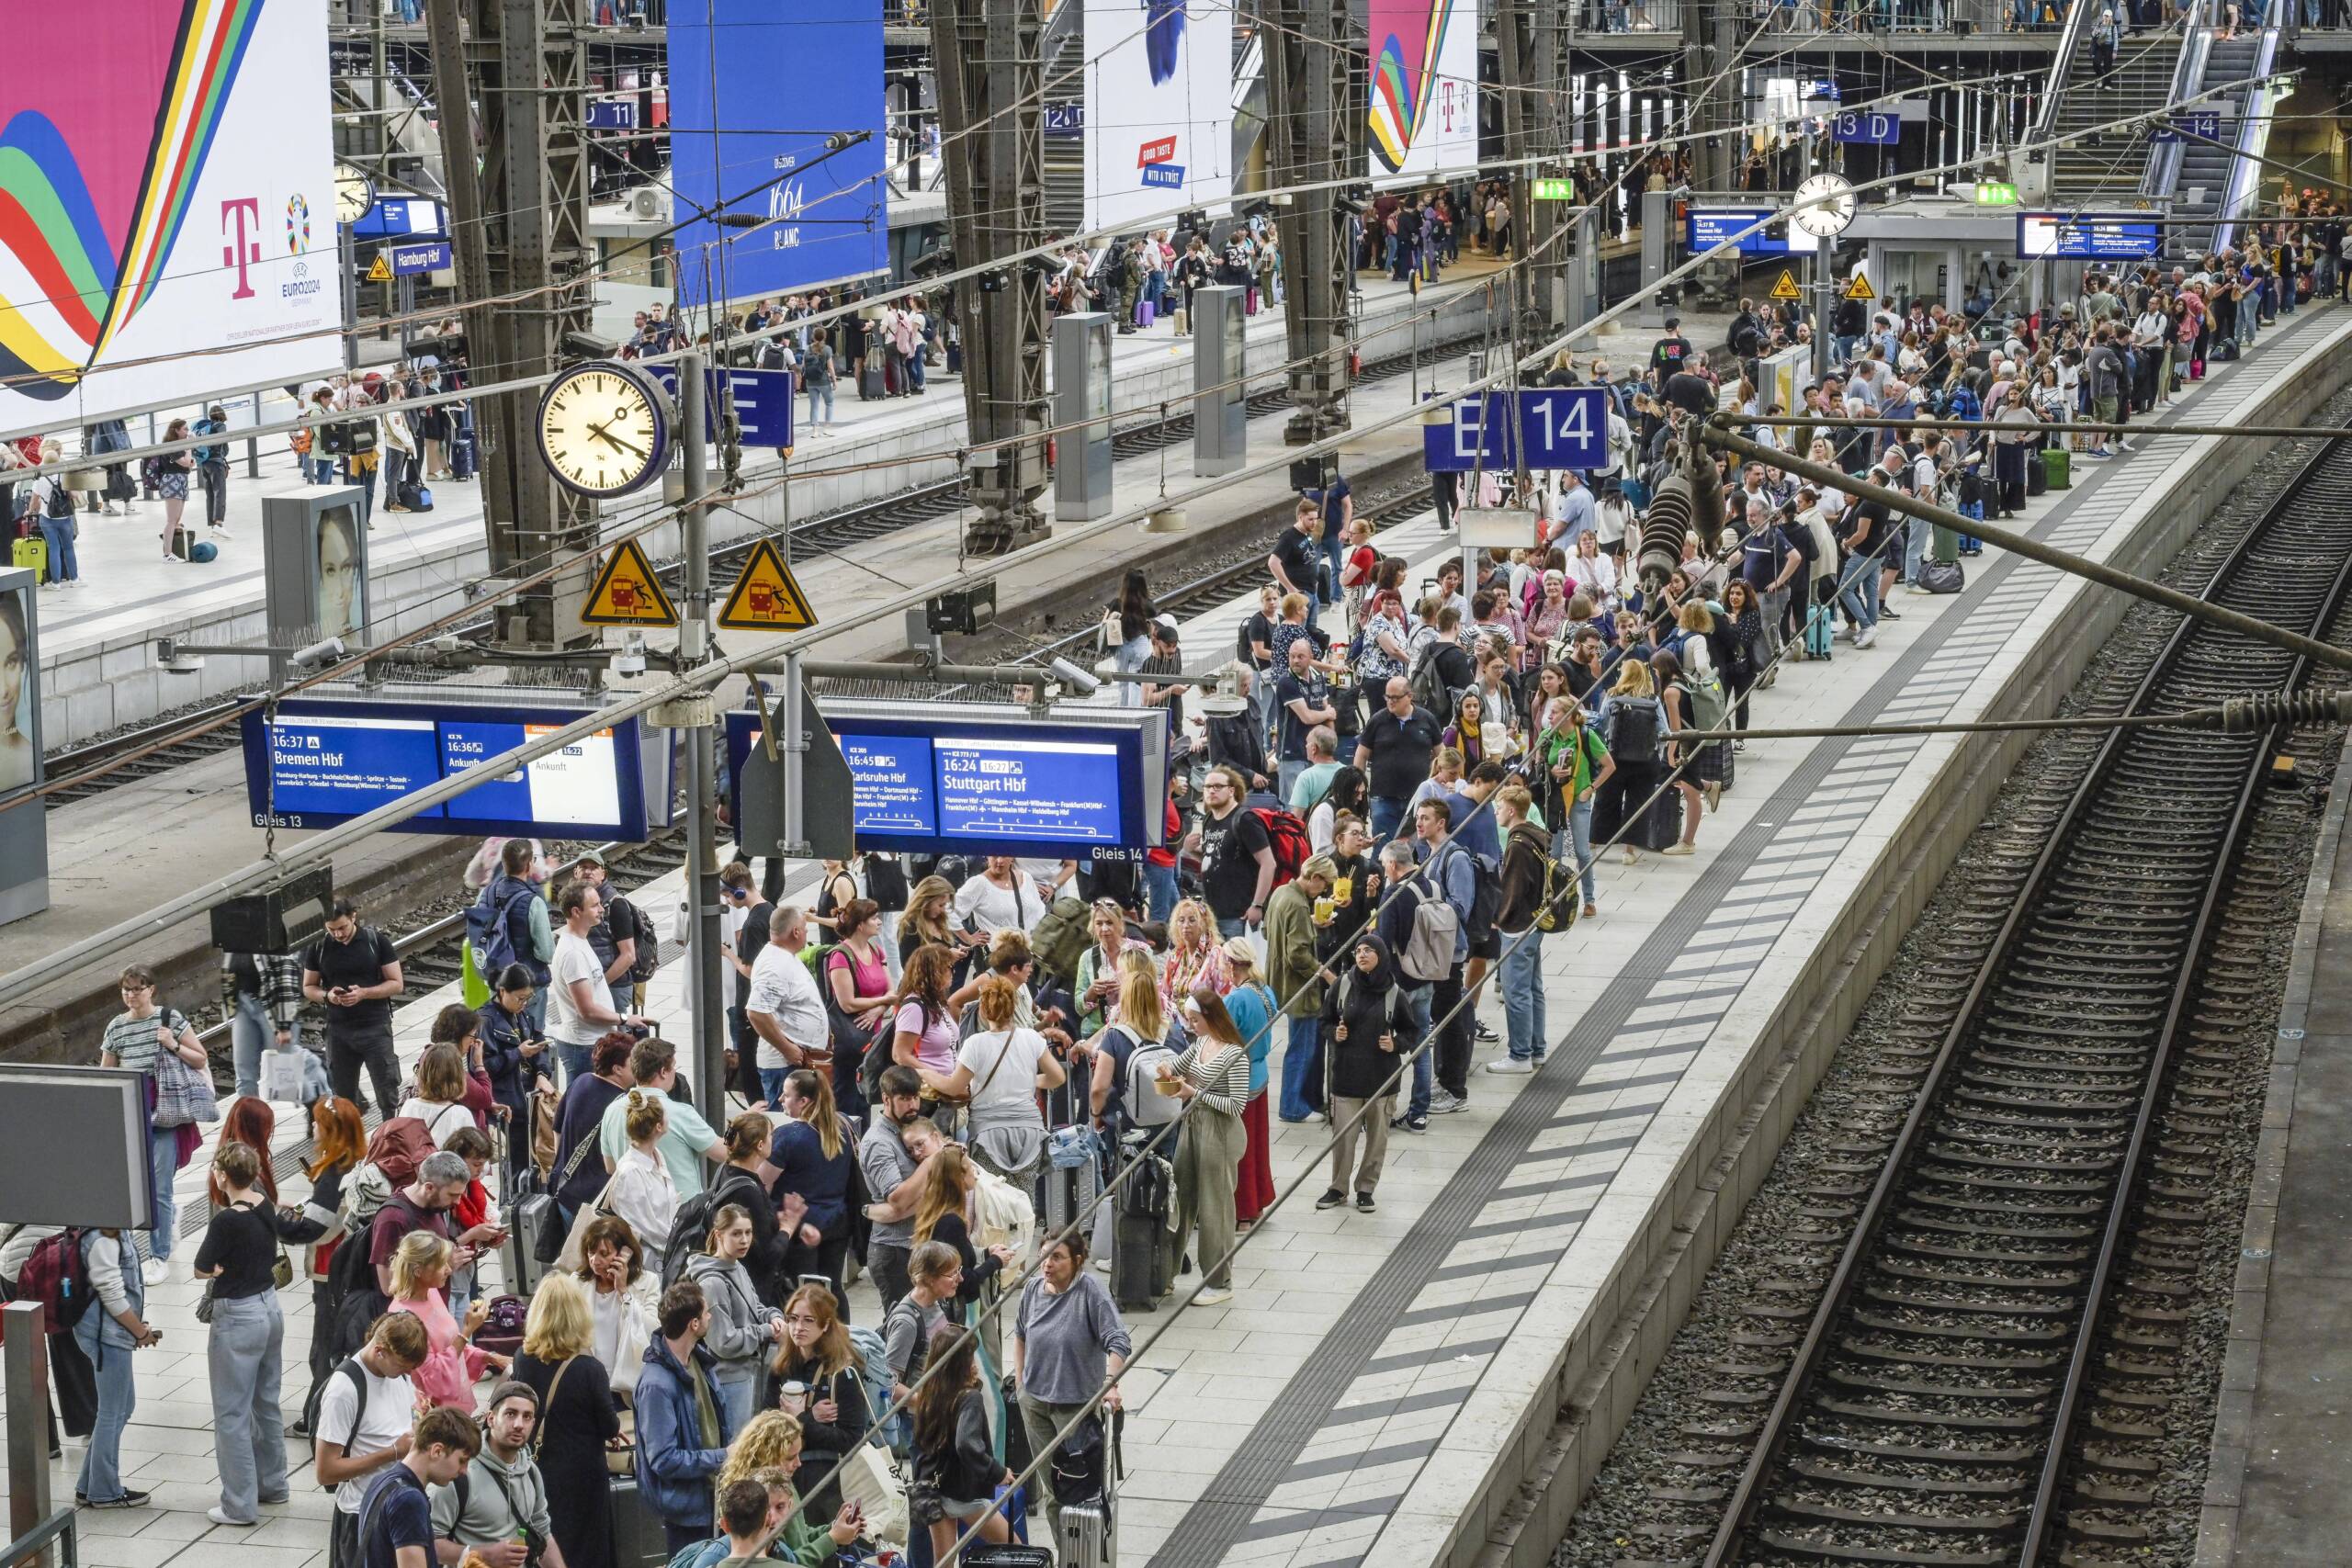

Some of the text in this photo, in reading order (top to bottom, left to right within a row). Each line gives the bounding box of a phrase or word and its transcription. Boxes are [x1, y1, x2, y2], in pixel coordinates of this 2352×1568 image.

[613, 104, 628, 124] 11
[1443, 82, 1454, 132] T
[1044, 107, 1063, 128] 12
[2195, 114, 2215, 135] 14
[1837, 114, 1889, 139] 13 D
[1143, 143, 1170, 162] GOOD TASTE
[1148, 169, 1159, 183] WITH
[1159, 172, 1164, 183] A
[769, 177, 806, 220] 1664
[775, 227, 799, 250] BLANC
[221, 197, 260, 299] T
[398, 249, 441, 267] Hamburg Hbf
[1453, 397, 1594, 457] E 14
[273, 736, 303, 749] 16:37
[447, 742, 473, 752] 16:36
[563, 747, 582, 755] 16:22
[275, 750, 344, 767] Bremen Hbf
[448, 757, 481, 768] Ankunft
[849, 755, 875, 766] 16:45
[944, 759, 1006, 772] 16:24 16:27
[536, 761, 567, 772] Ankunft
[890, 773, 907, 784] Hbf
[944, 774, 1026, 794] Stuttgart Hbf
[876, 794, 910, 802] Frankfurt(M)
[944, 795, 968, 804] Hannover
[983, 797, 1008, 806] Göttingen
[945, 804, 978, 812] Frankfurt(M)
[1032, 807, 1059, 816] Heidelberg
[254, 814, 302, 828] Gleis 13
[1092, 847, 1143, 861] Gleis 14
